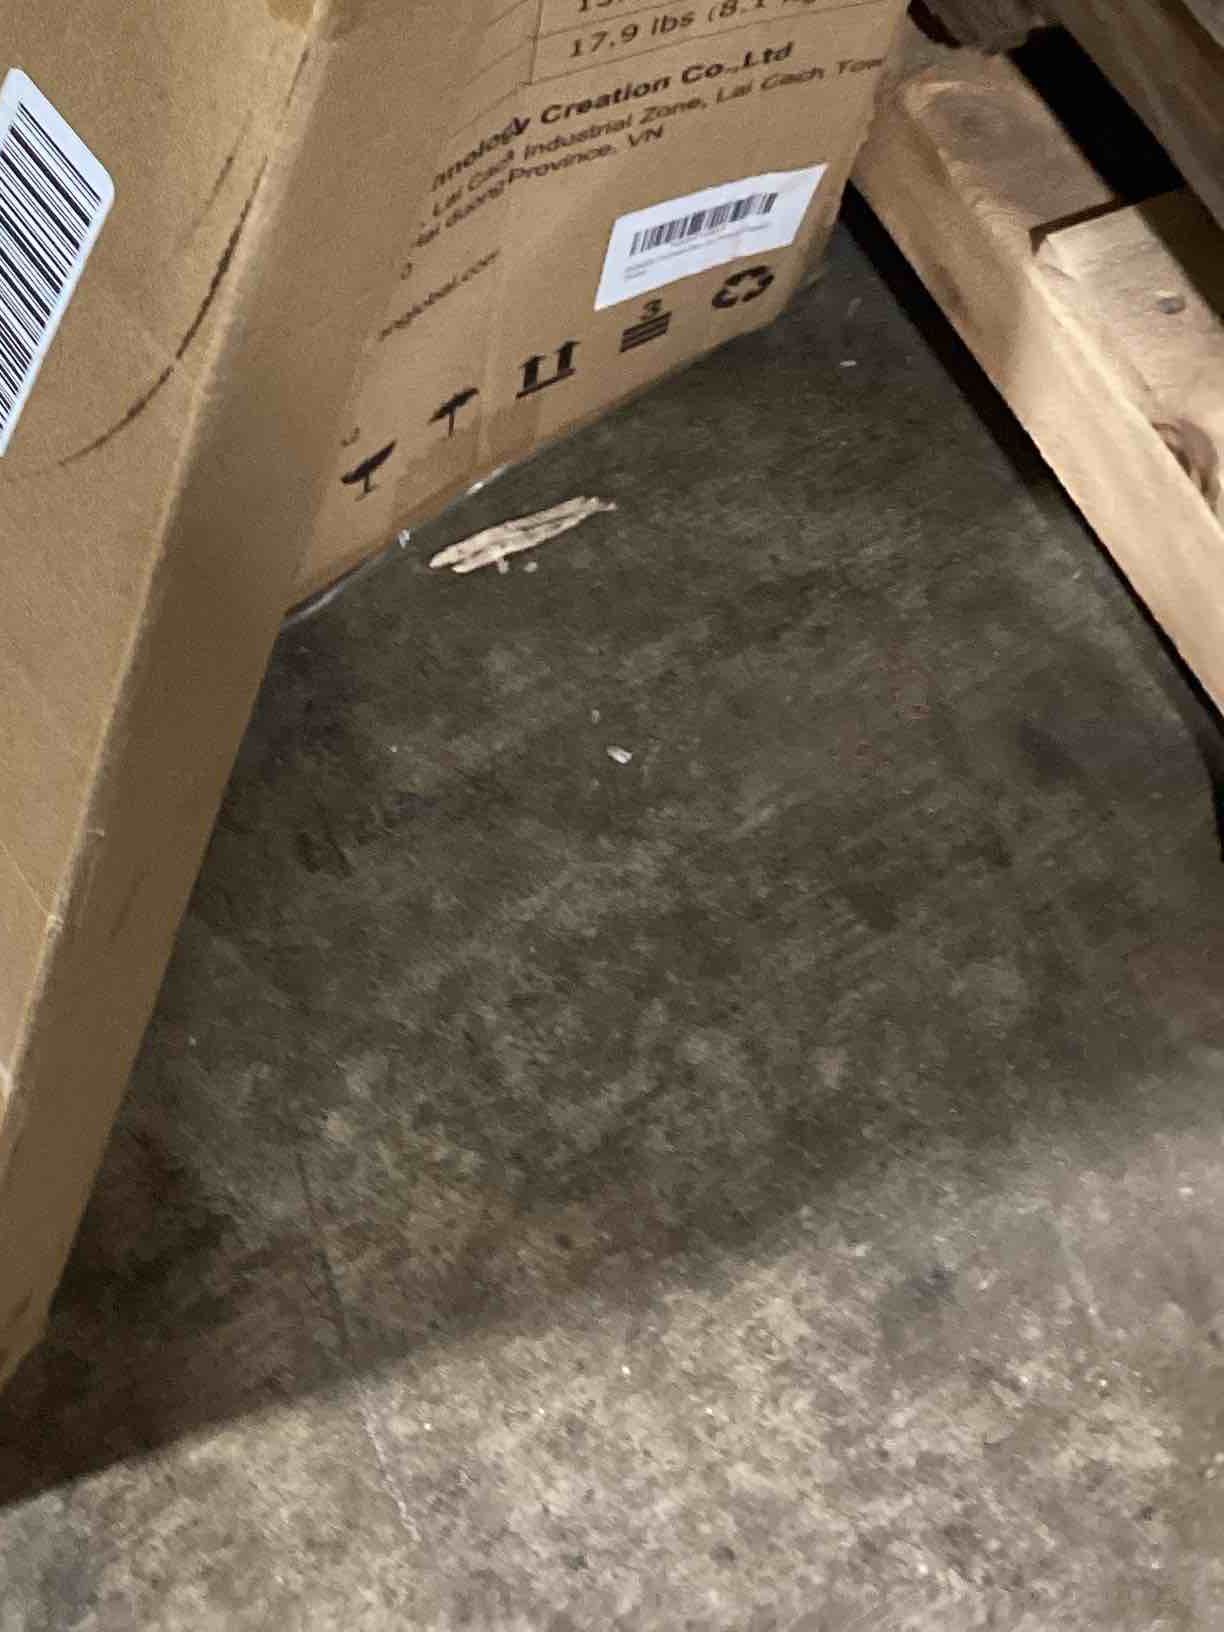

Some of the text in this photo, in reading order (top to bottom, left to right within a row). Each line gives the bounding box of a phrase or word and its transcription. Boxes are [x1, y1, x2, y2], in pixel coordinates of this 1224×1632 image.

[570, 24, 638, 58] 17.9
[651, 13, 695, 36] lbs
[541, 76, 672, 125] Creation
[525, 114, 632, 160] Industrial
[639, 98, 707, 125] Zone,
[628, 126, 664, 148] VN
